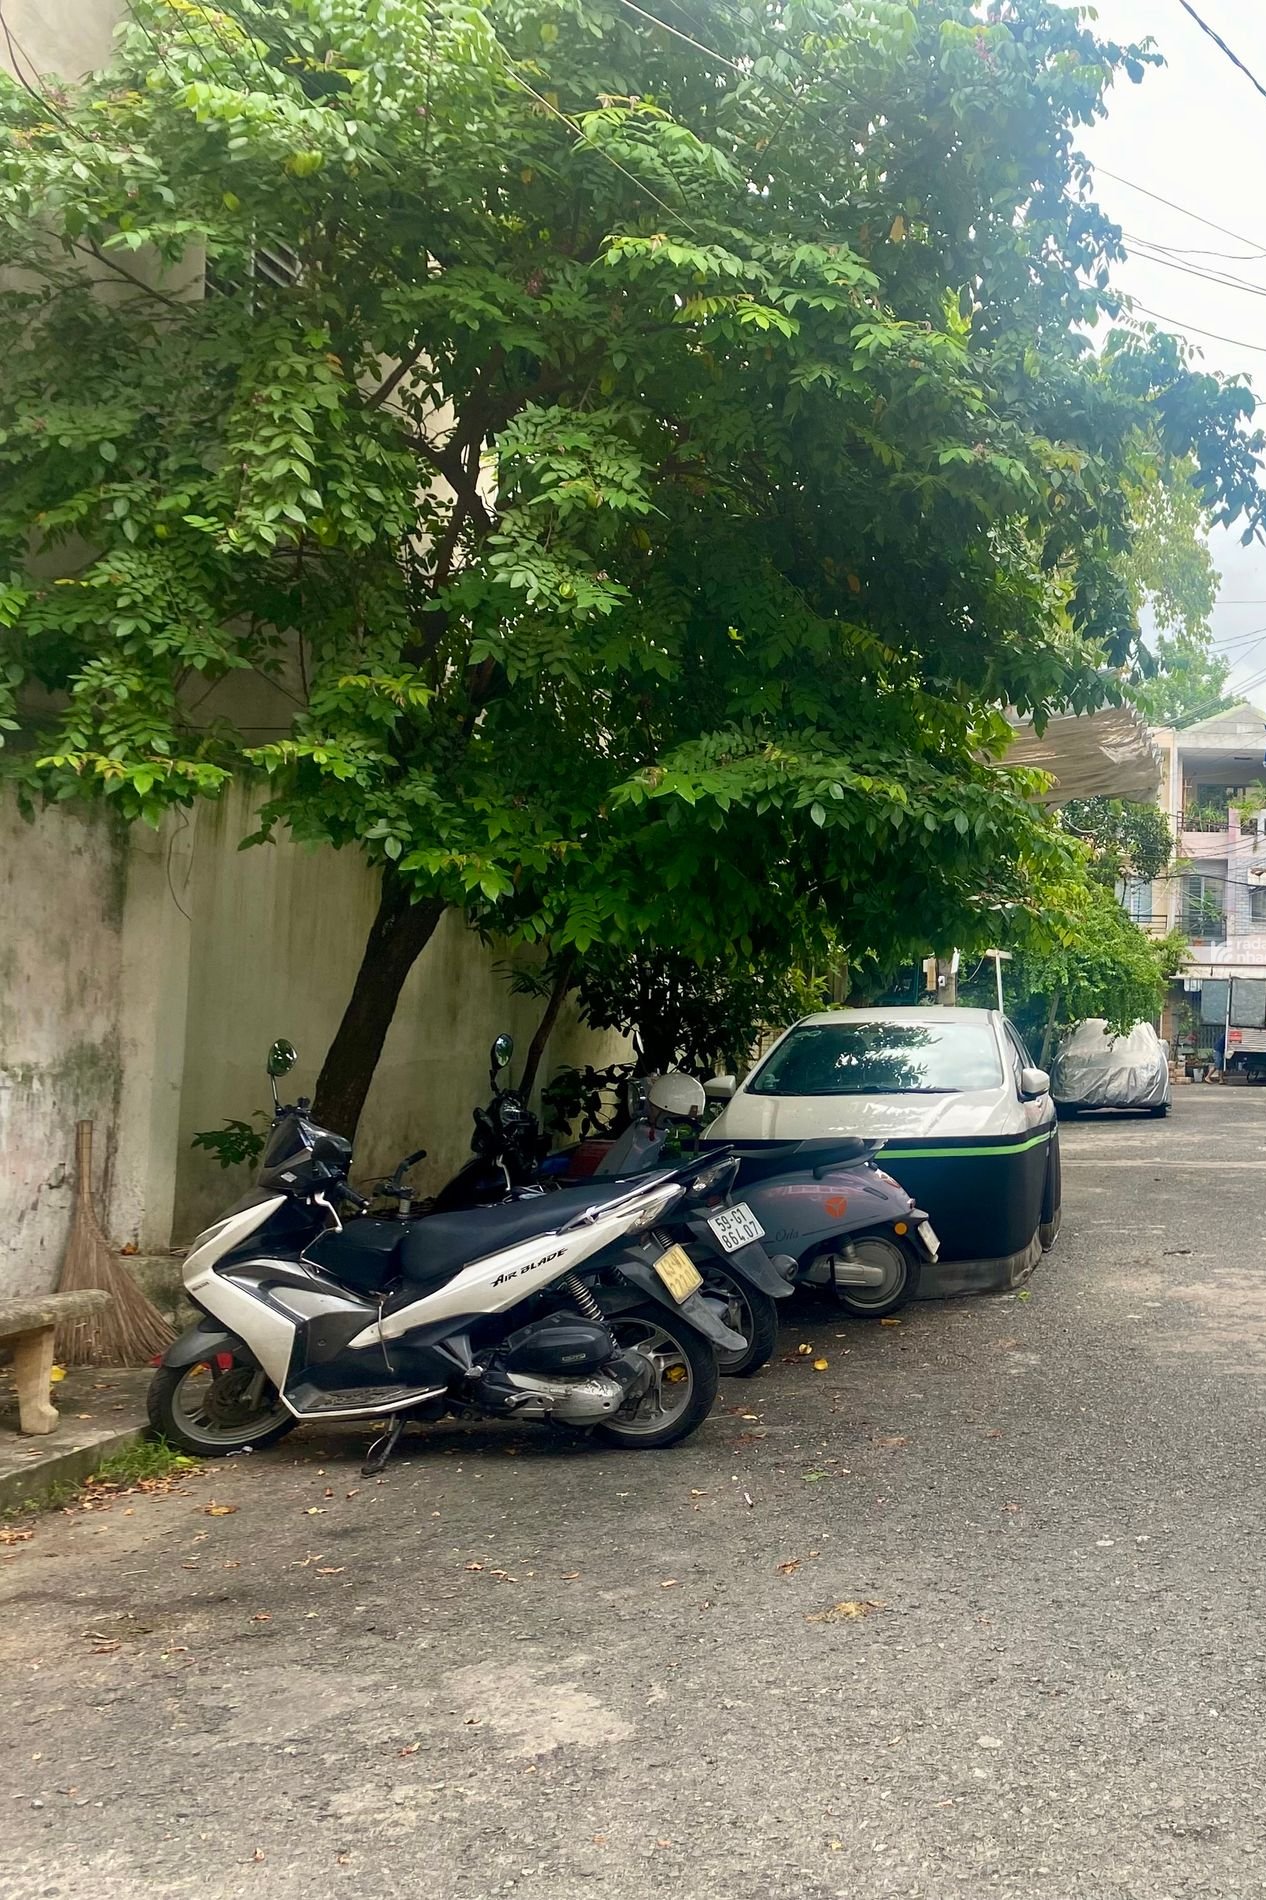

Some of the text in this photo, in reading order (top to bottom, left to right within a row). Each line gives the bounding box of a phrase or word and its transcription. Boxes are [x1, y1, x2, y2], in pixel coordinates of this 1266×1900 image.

[714, 1208, 748, 1232] 59-G1
[721, 1221, 759, 1249] 864.07
[490, 1248, 568, 1288] AIR BLADE
